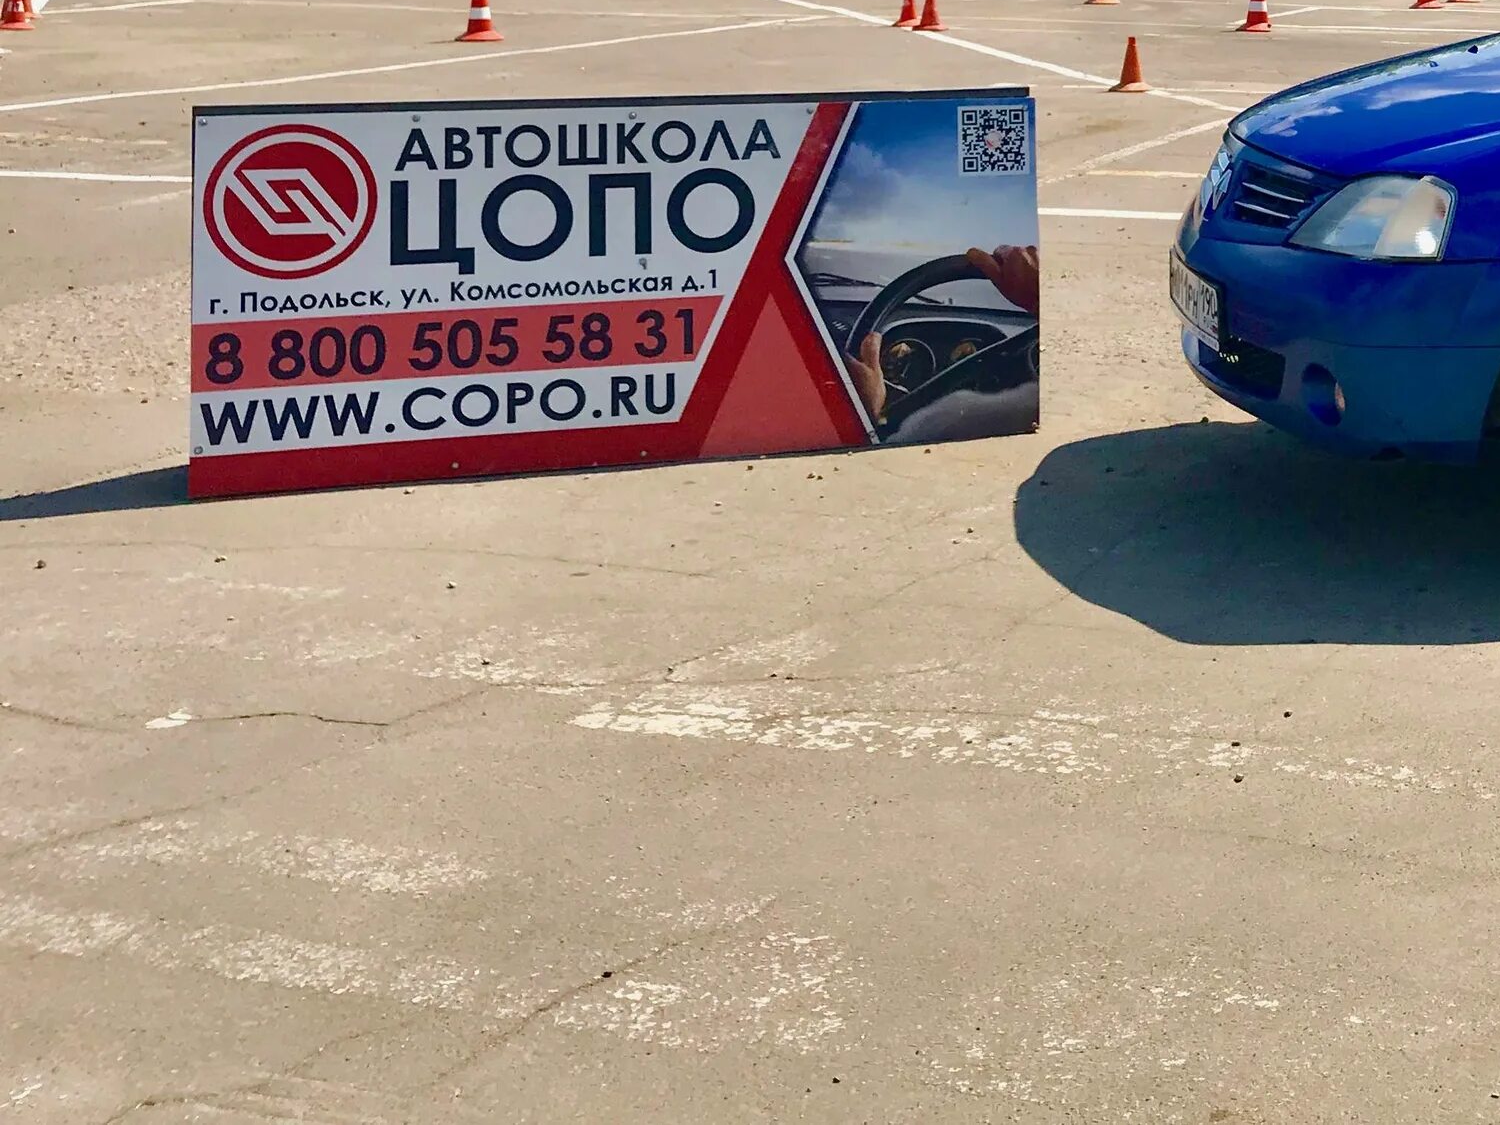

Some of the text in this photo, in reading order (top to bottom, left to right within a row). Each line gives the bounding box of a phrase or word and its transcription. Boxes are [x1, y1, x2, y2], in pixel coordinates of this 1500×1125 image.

[395, 118, 781, 171] АВТОШКОЛА
[390, 167, 756, 274] ЦОПО
[209, 269, 719, 316] г. Подольск, ул. Комсомольская д.1
[204, 308, 696, 383] 8 800 505 58 31
[200, 372, 677, 445] WWW.COPO.RU
